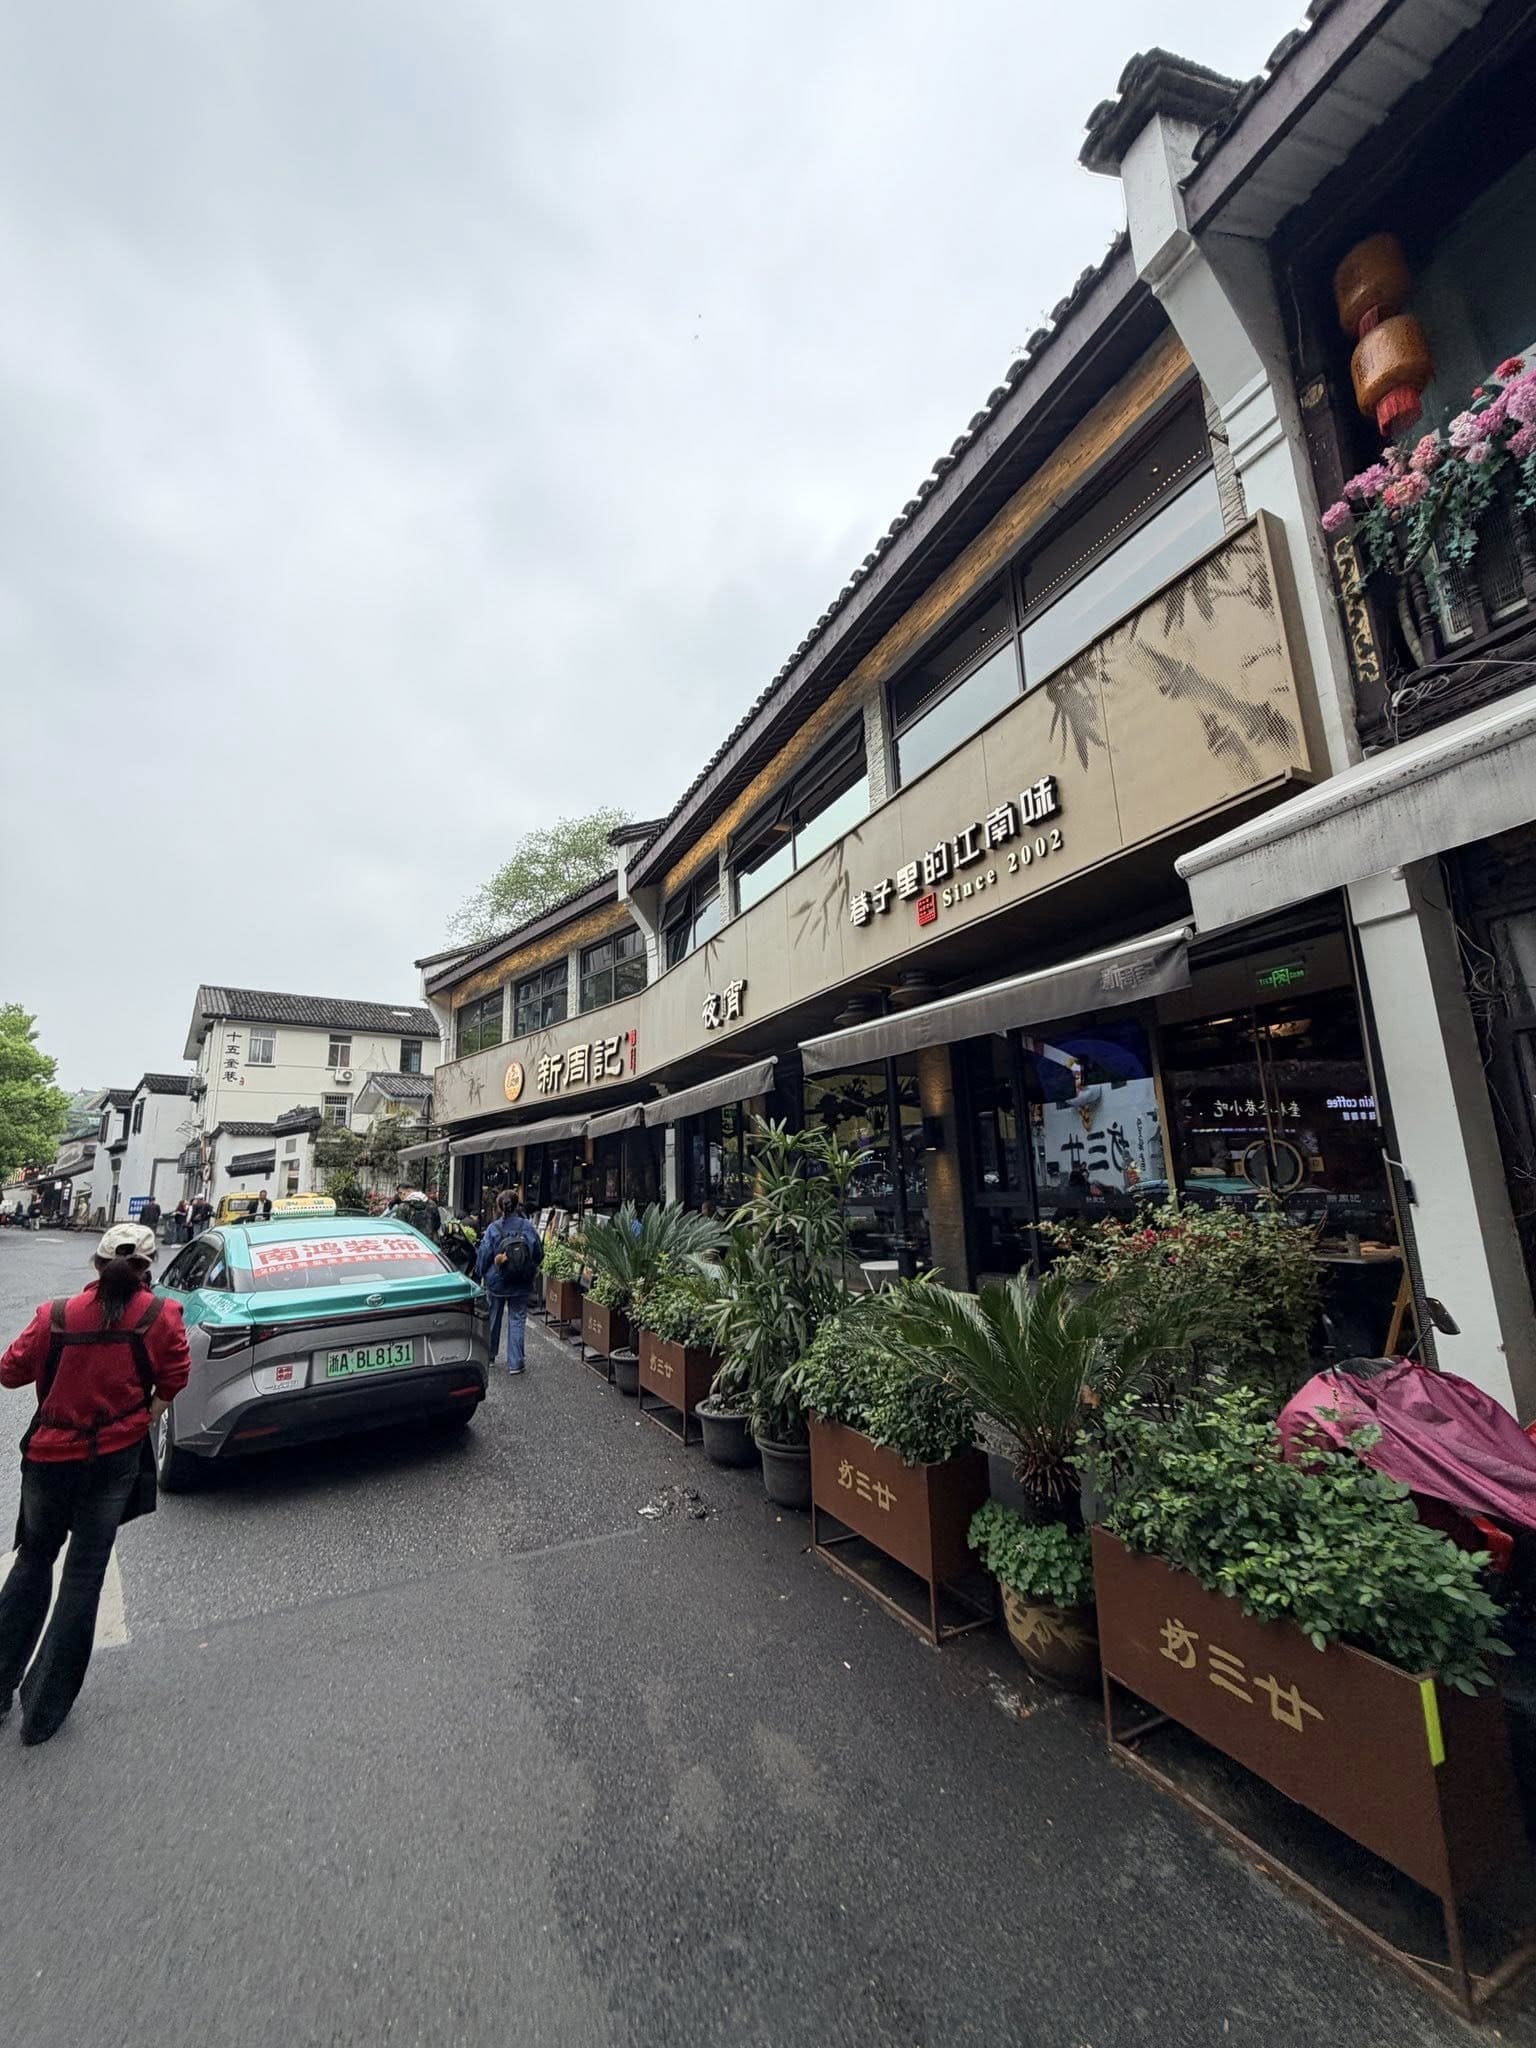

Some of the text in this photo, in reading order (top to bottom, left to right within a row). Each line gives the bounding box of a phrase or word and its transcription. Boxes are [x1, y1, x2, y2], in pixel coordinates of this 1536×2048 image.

[849, 775, 1058, 926] 巷子里的江南味
[942, 828, 1063, 908] Since 2002
[702, 979, 746, 1029] 夜宵
[256, 1238, 420, 1265] 南鸿装饰
